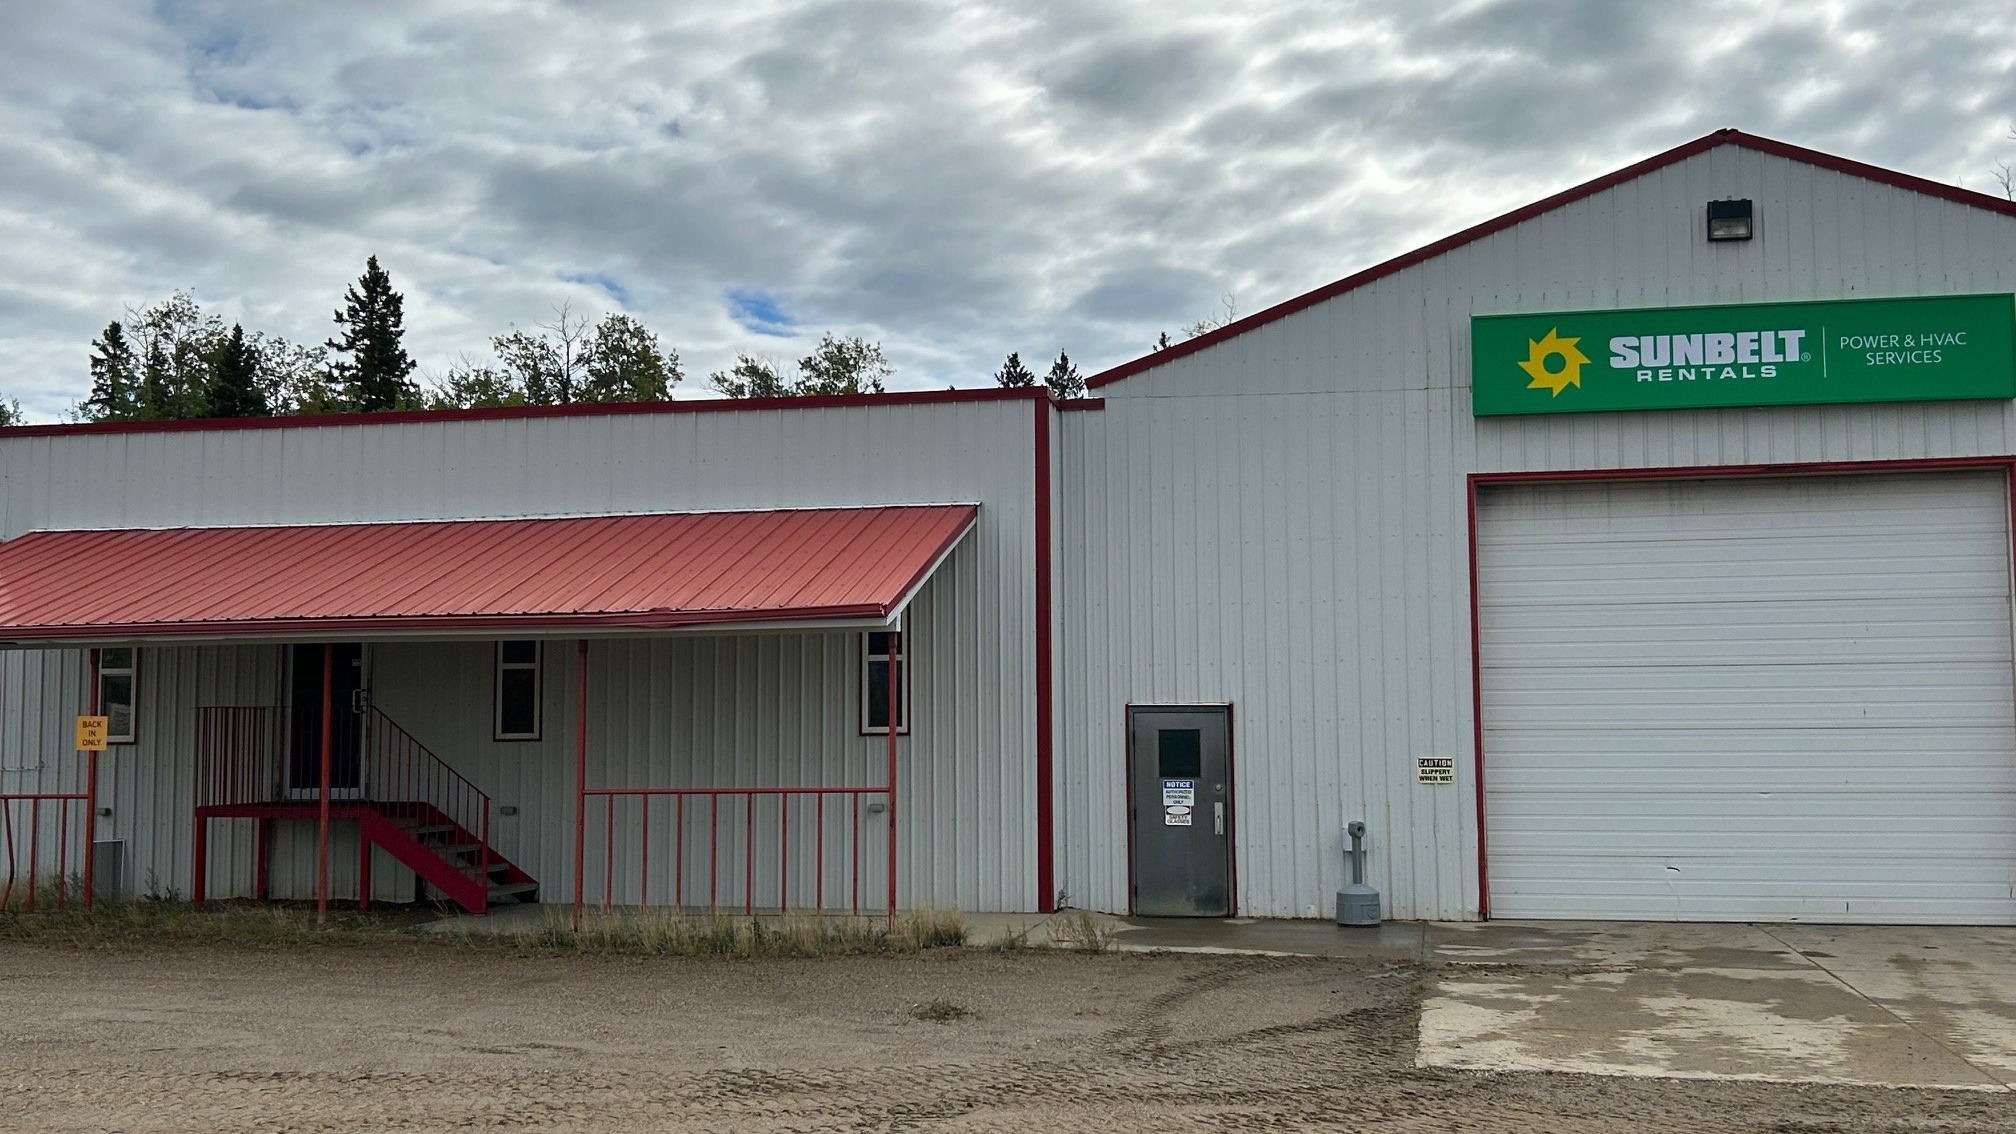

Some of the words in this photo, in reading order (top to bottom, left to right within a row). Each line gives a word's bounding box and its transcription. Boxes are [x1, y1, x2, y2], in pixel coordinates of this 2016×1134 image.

[1840, 334, 1899, 350] POWER
[1904, 333, 1916, 348] &
[1920, 331, 1967, 347] HVAC
[1866, 350, 1942, 366] SERVICES
[1636, 365, 1778, 382] RENTALS
[88, 729, 97, 737] IN
[82, 739, 102, 747] ONLY
[1419, 759, 1452, 767] CAUTION
